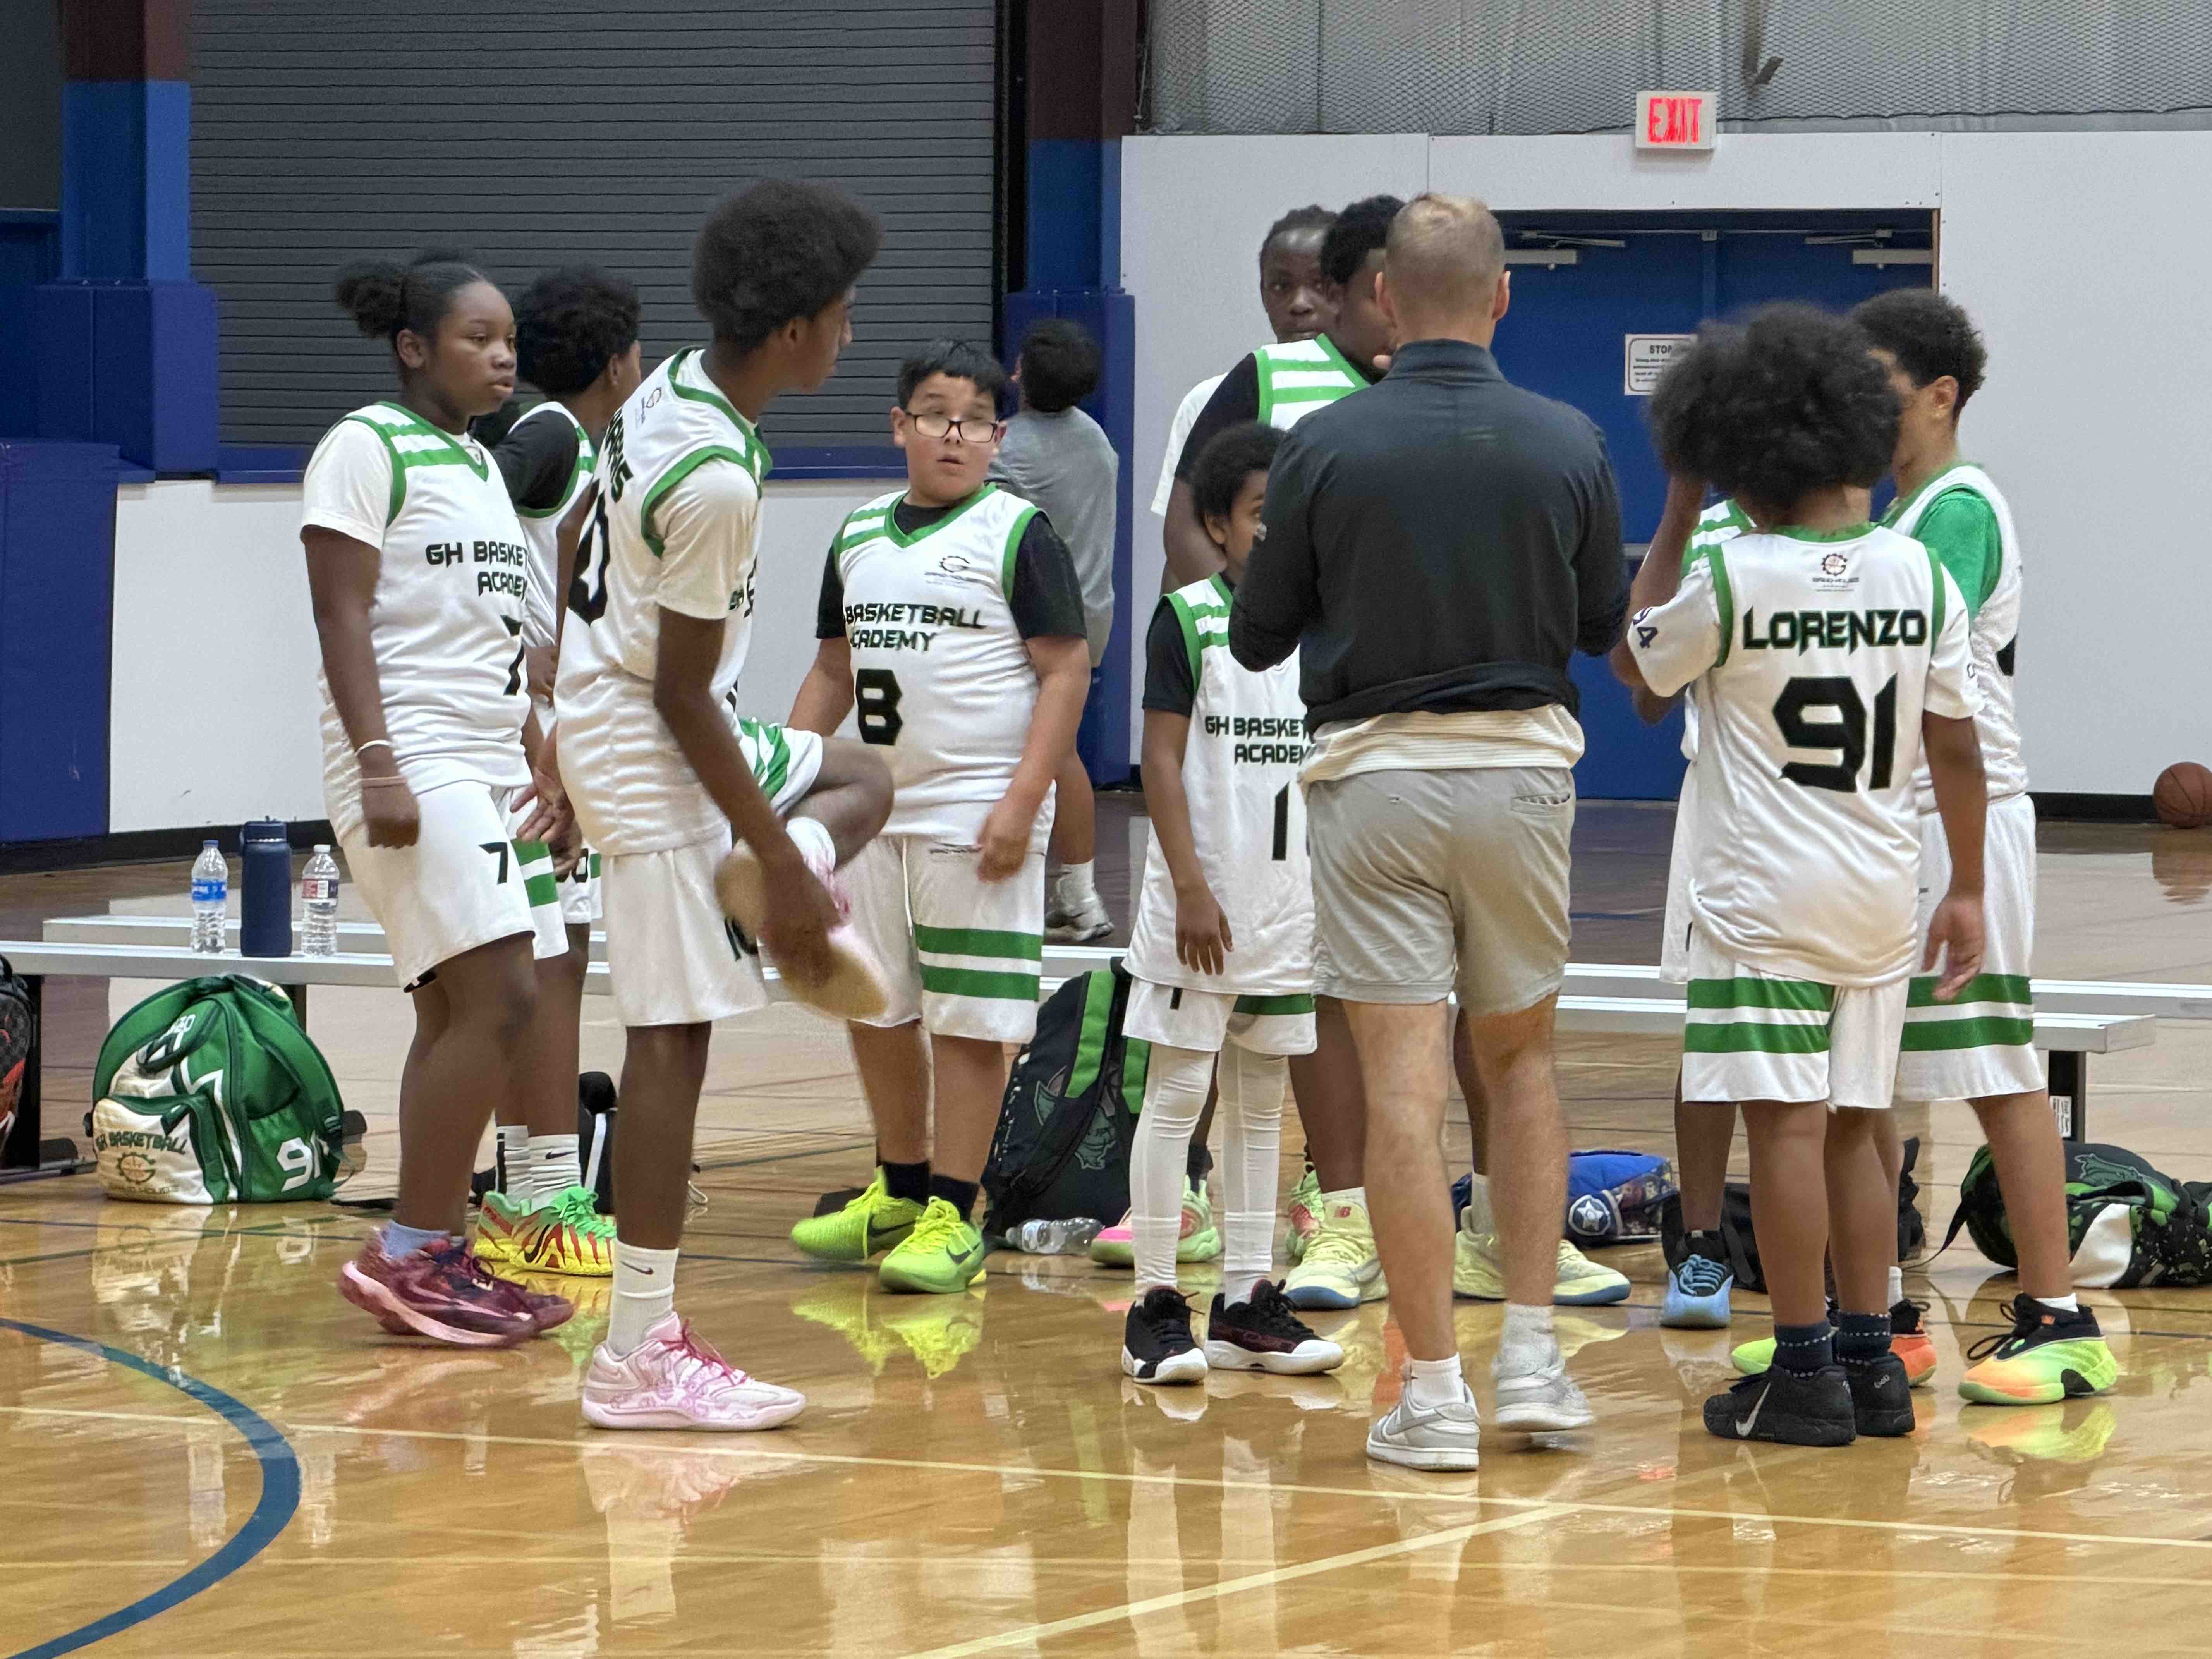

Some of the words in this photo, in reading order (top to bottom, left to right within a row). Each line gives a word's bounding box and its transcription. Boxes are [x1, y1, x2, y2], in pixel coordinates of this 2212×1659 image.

[1649, 98, 1702, 143] EXIT
[426, 542, 463, 568] GH
[845, 603, 988, 629] BASKETBALL
[1743, 606, 1927, 656] LORENZO
[855, 668, 903, 746] 8
[1205, 715, 1229, 738] GH
[1773, 672, 1898, 793] 91
[1272, 780, 1290, 861] 1
[479, 842, 508, 885] 7
[108, 1131, 187, 1155] BASKETBALL
